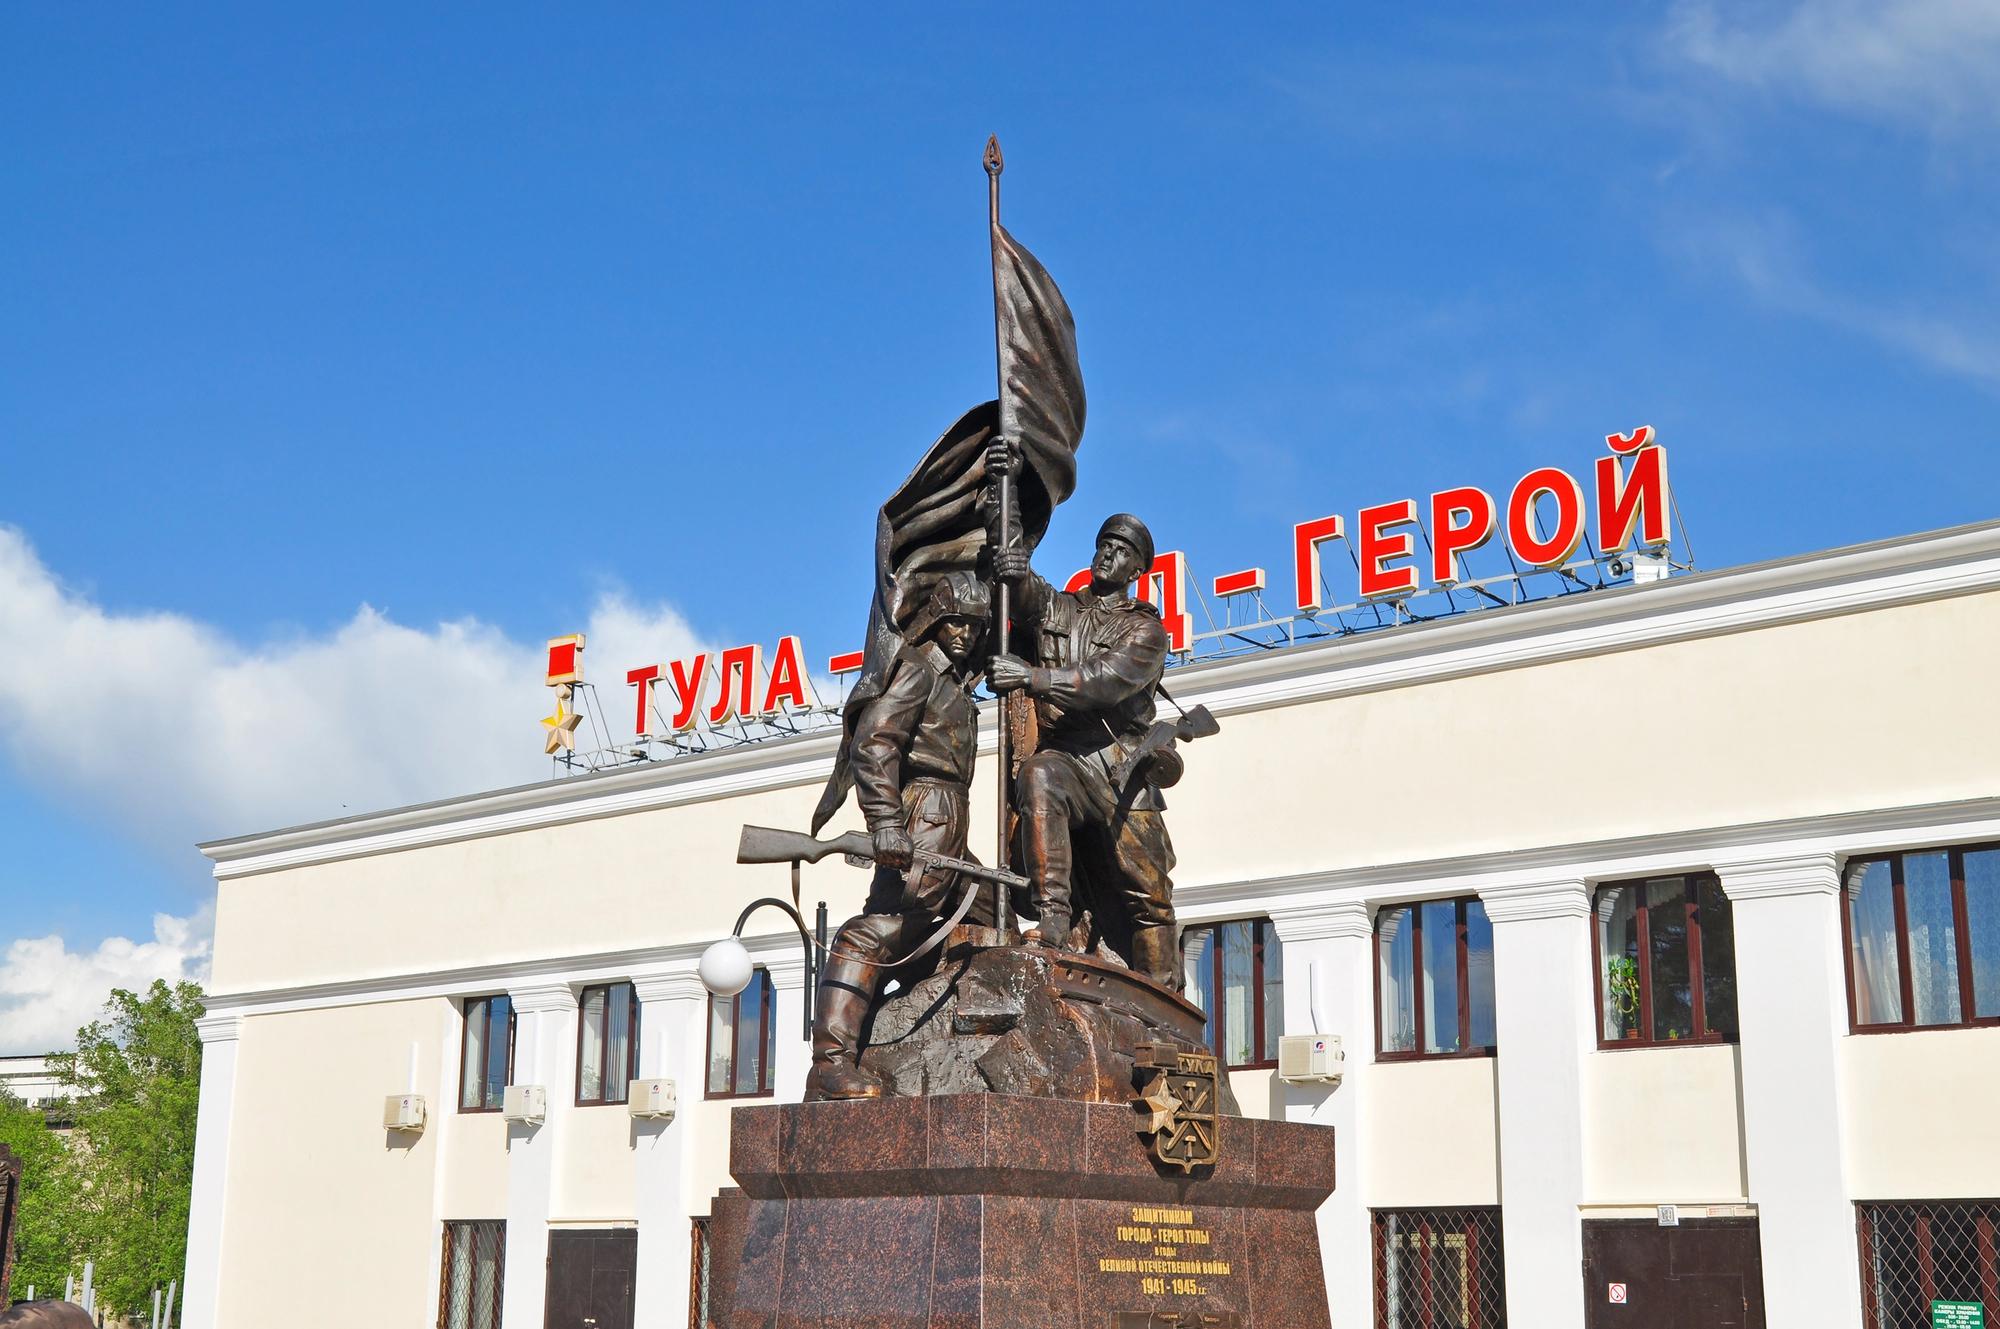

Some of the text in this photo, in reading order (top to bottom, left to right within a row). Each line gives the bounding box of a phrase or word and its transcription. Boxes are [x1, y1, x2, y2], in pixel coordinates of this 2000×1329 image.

[626, 635, 812, 737] ТУЛА
[1294, 424, 1671, 612] ГЕРОЙ
[1177, 1056, 1215, 1074] ТУЛА
[1132, 1207, 1193, 1224] ЗАЩИТНИКАМ
[1117, 1226, 1152, 1244] ГОРОДА
[1158, 1228, 1184, 1243] ГЕРОЯ
[1185, 1229, 1210, 1244] ТУЛЫ
[1160, 1246, 1177, 1257] ГОДЫ
[1100, 1258, 1231, 1275] ВЕЛИКОЙ ОТЕЧЕСТВЕННОЙ ВОЙНЫ
[1142, 1278, 1165, 1295] 1941
[1171, 1279, 1197, 1295] 1945
